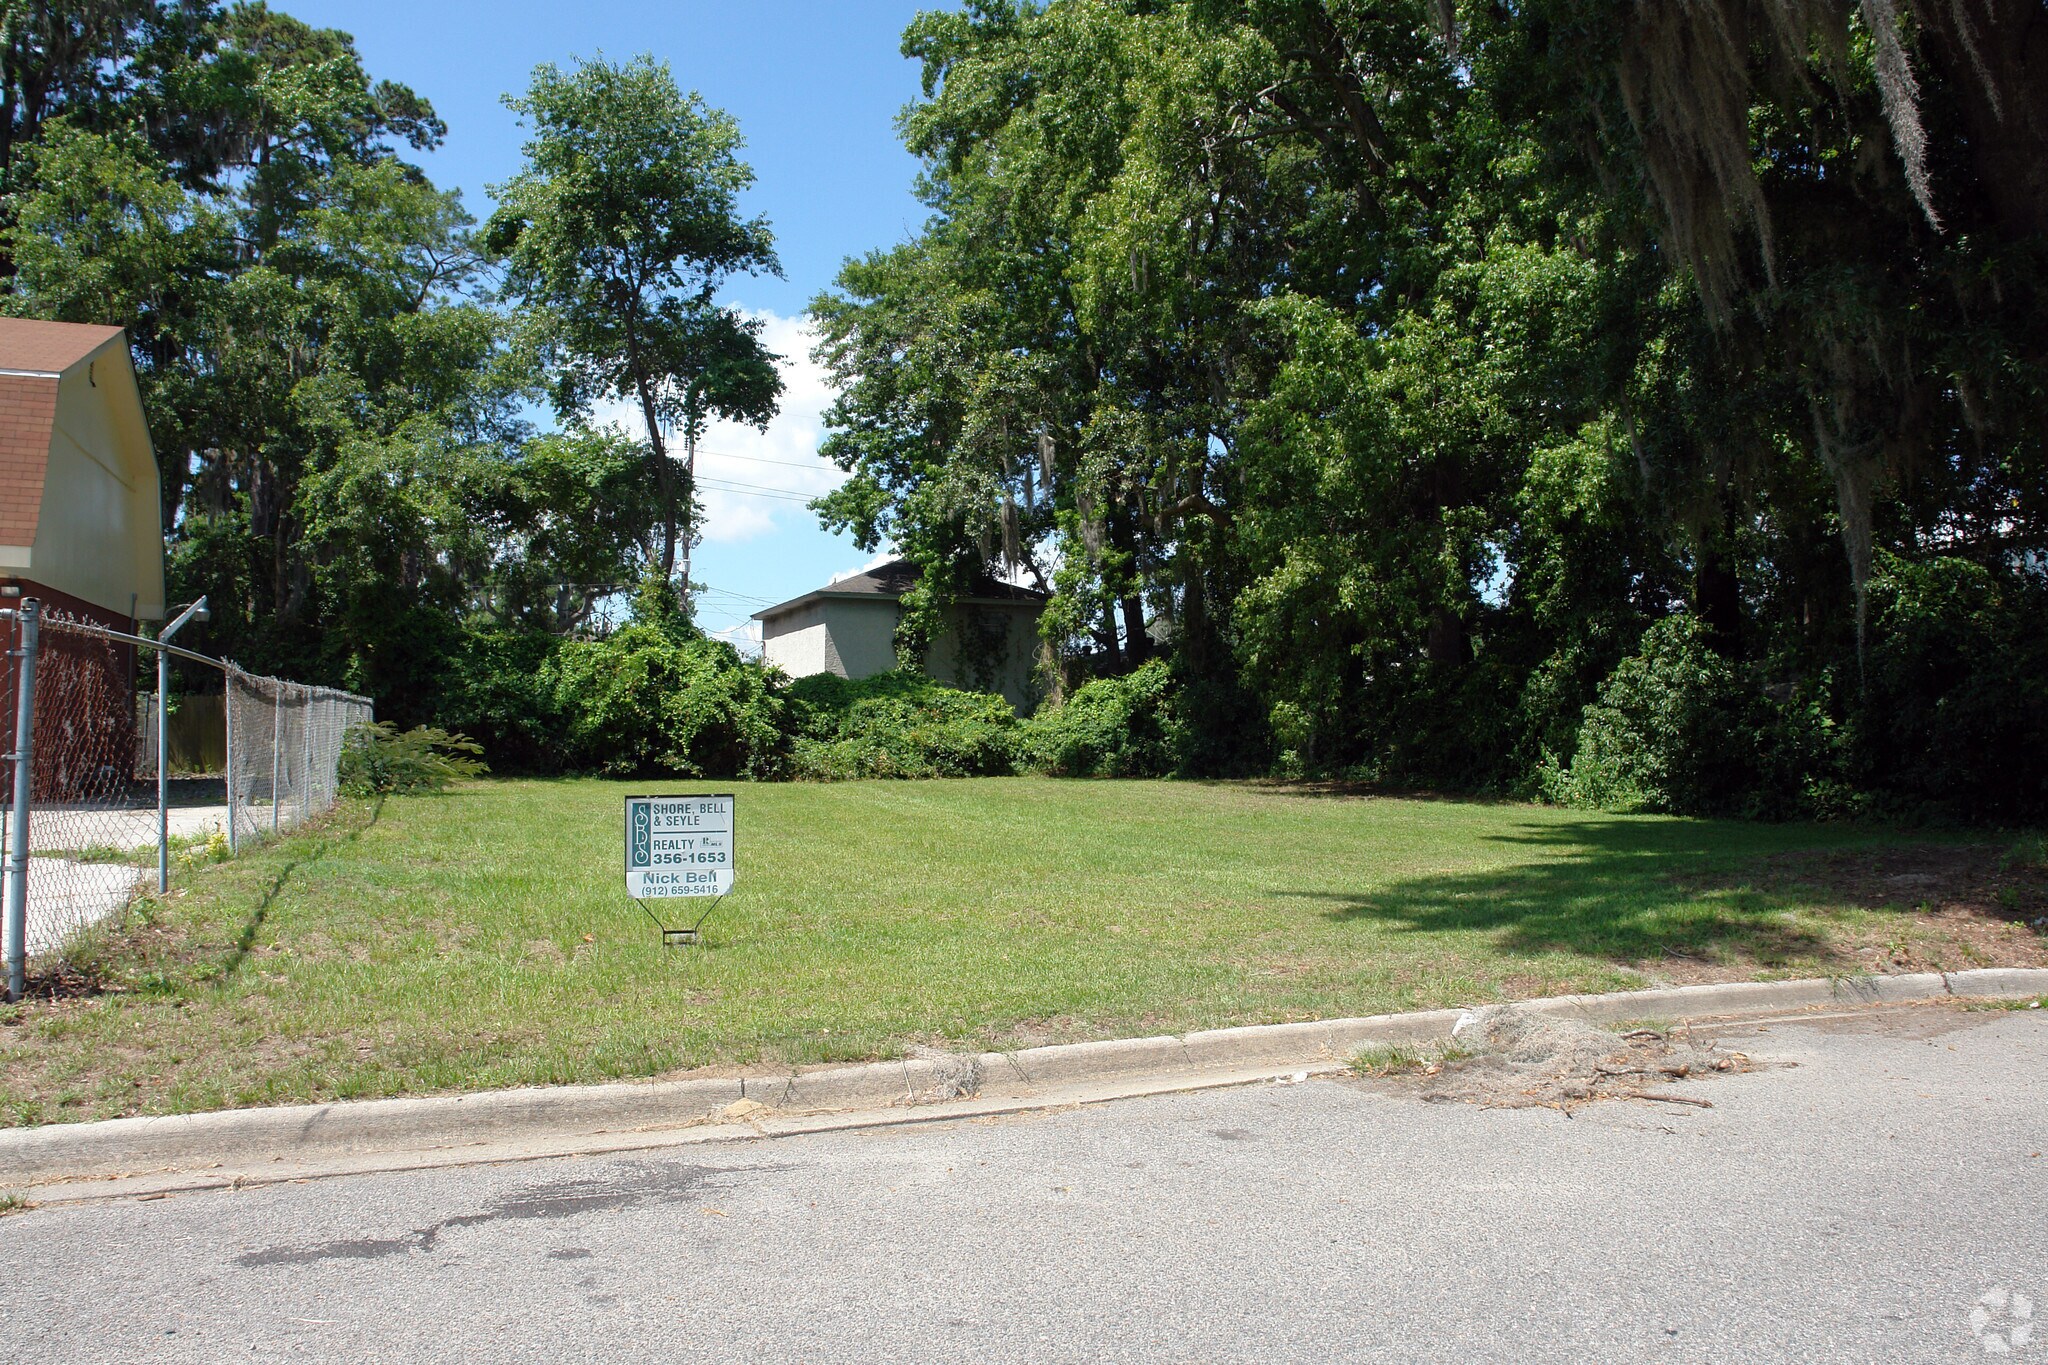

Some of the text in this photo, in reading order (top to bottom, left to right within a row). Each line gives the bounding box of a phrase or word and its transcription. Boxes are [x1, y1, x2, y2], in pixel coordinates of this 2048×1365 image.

[653, 803, 726, 815] SHORE, BELL
[653, 815, 700, 827] & SEYLE
[653, 839, 695, 851] REALTY
[653, 852, 726, 864] 356-1653
[643, 871, 717, 884] Nick Bell
[641, 885, 718, 897] (912) 659-5416
